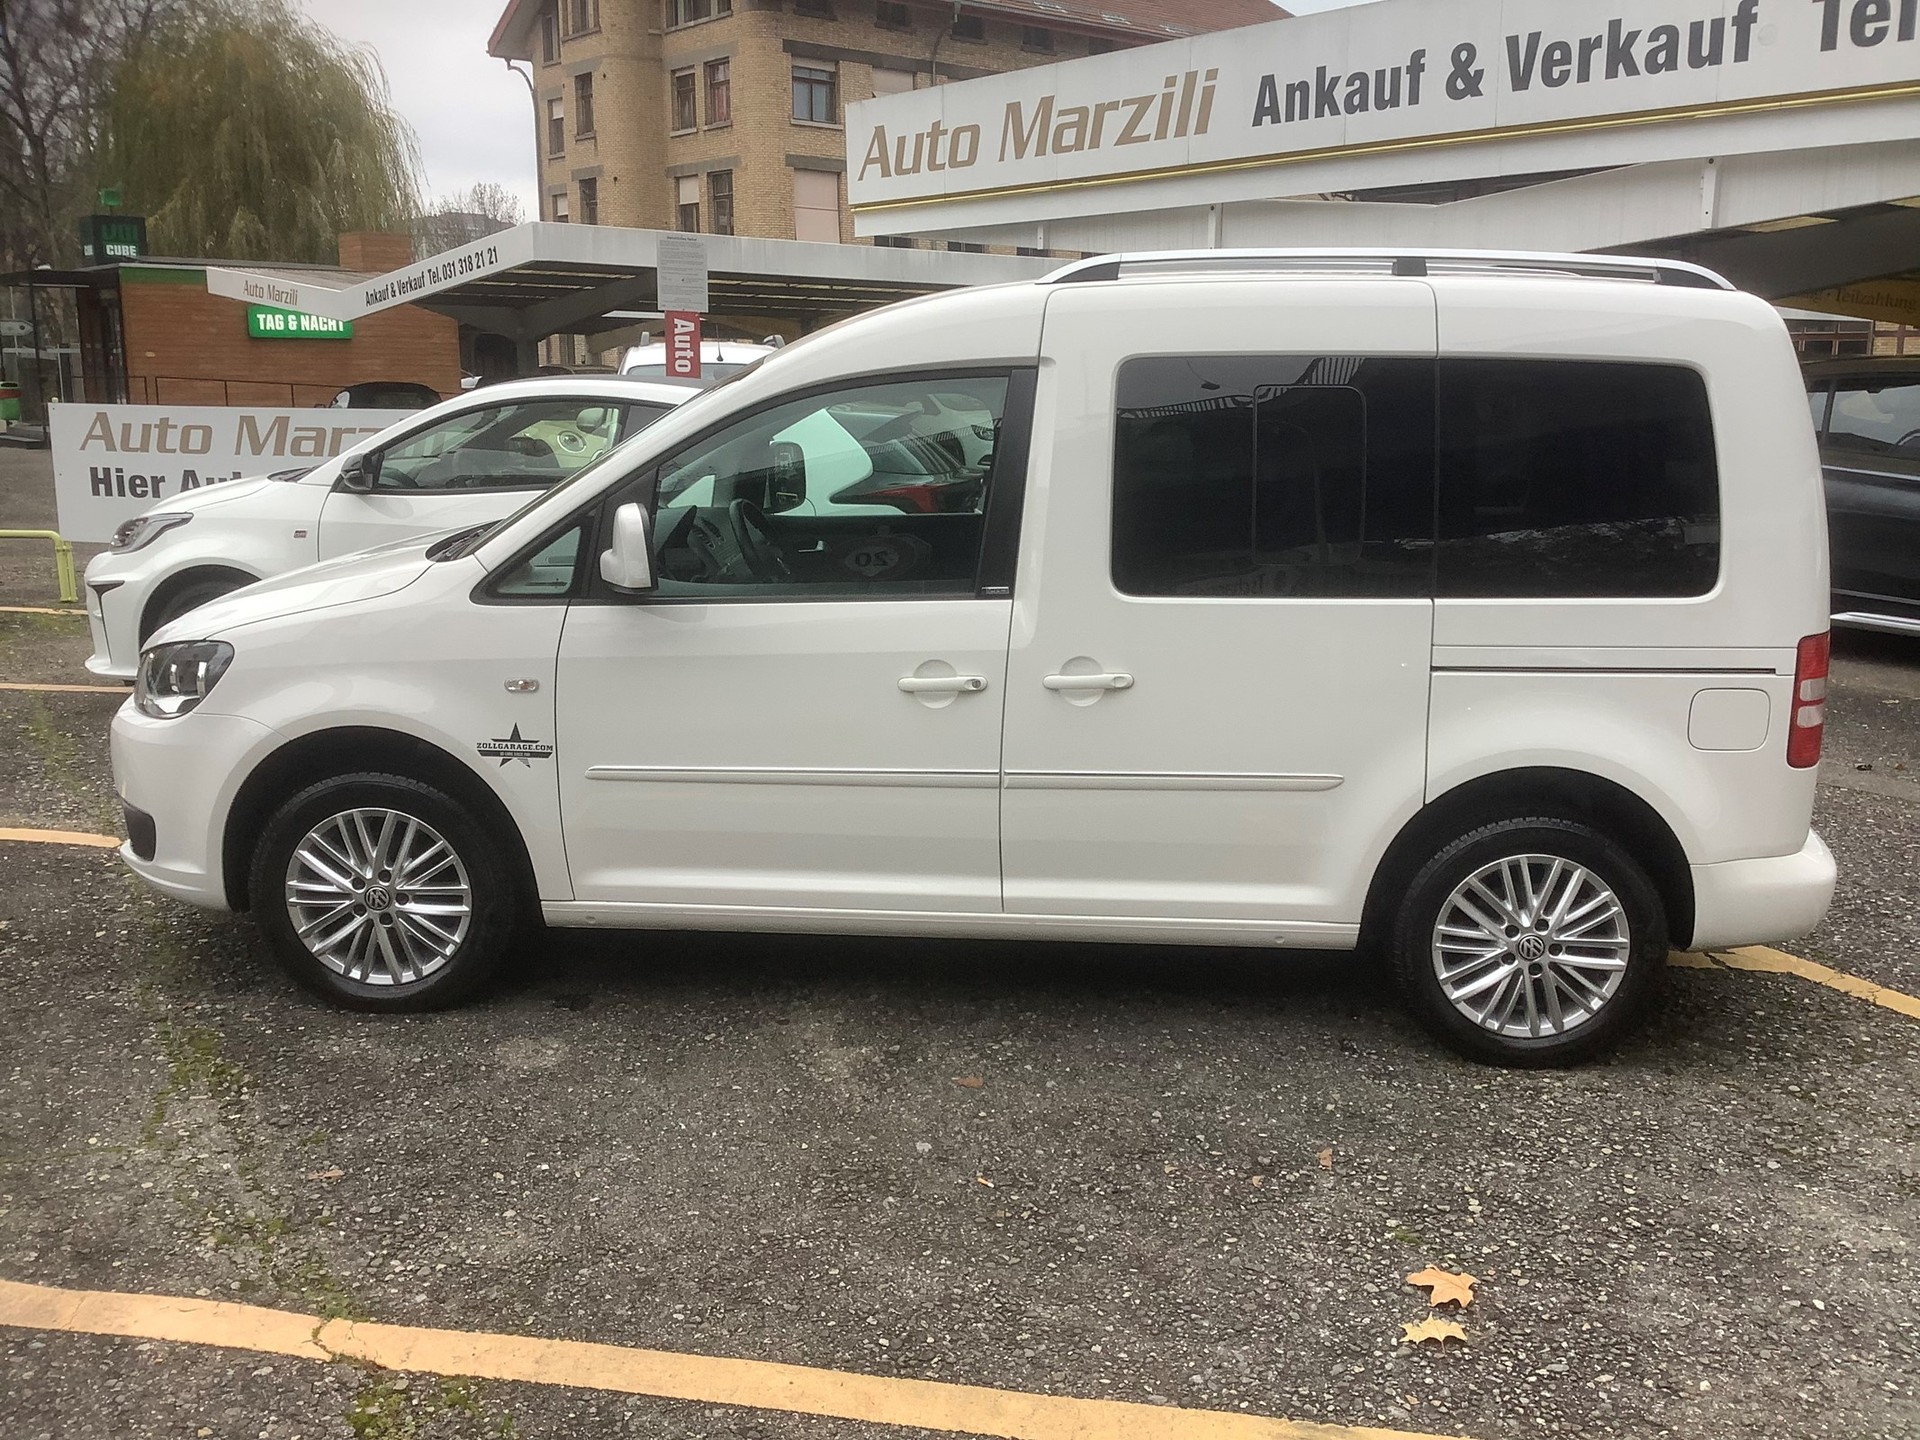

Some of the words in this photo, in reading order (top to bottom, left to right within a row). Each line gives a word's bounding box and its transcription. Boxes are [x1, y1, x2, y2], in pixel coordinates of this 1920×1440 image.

[857, 119, 981, 182] Auto
[998, 67, 1219, 163] Marzili
[1251, 49, 1427, 127] Ankauf
[1445, 42, 1484, 100] &
[1505, 0, 1758, 93] Verkauf
[105, 244, 137, 258] CUBE
[243, 279, 264, 299] Auto
[267, 284, 298, 305] Marzili
[365, 284, 389, 307] Ankauf
[390, 282, 397, 298] &
[397, 271, 425, 295] Verkauf
[442, 262, 457, 280] 031
[458, 254, 473, 275] 318
[475, 250, 485, 269] 21
[487, 246, 498, 265] 21
[257, 313, 285, 331] TAG
[287, 314, 298, 331] &
[674, 318, 695, 373] Auto
[79, 411, 213, 455] Auto
[89, 466, 166, 499] Hier
[476, 742, 554, 752] ZOLLGARAGE.COM
